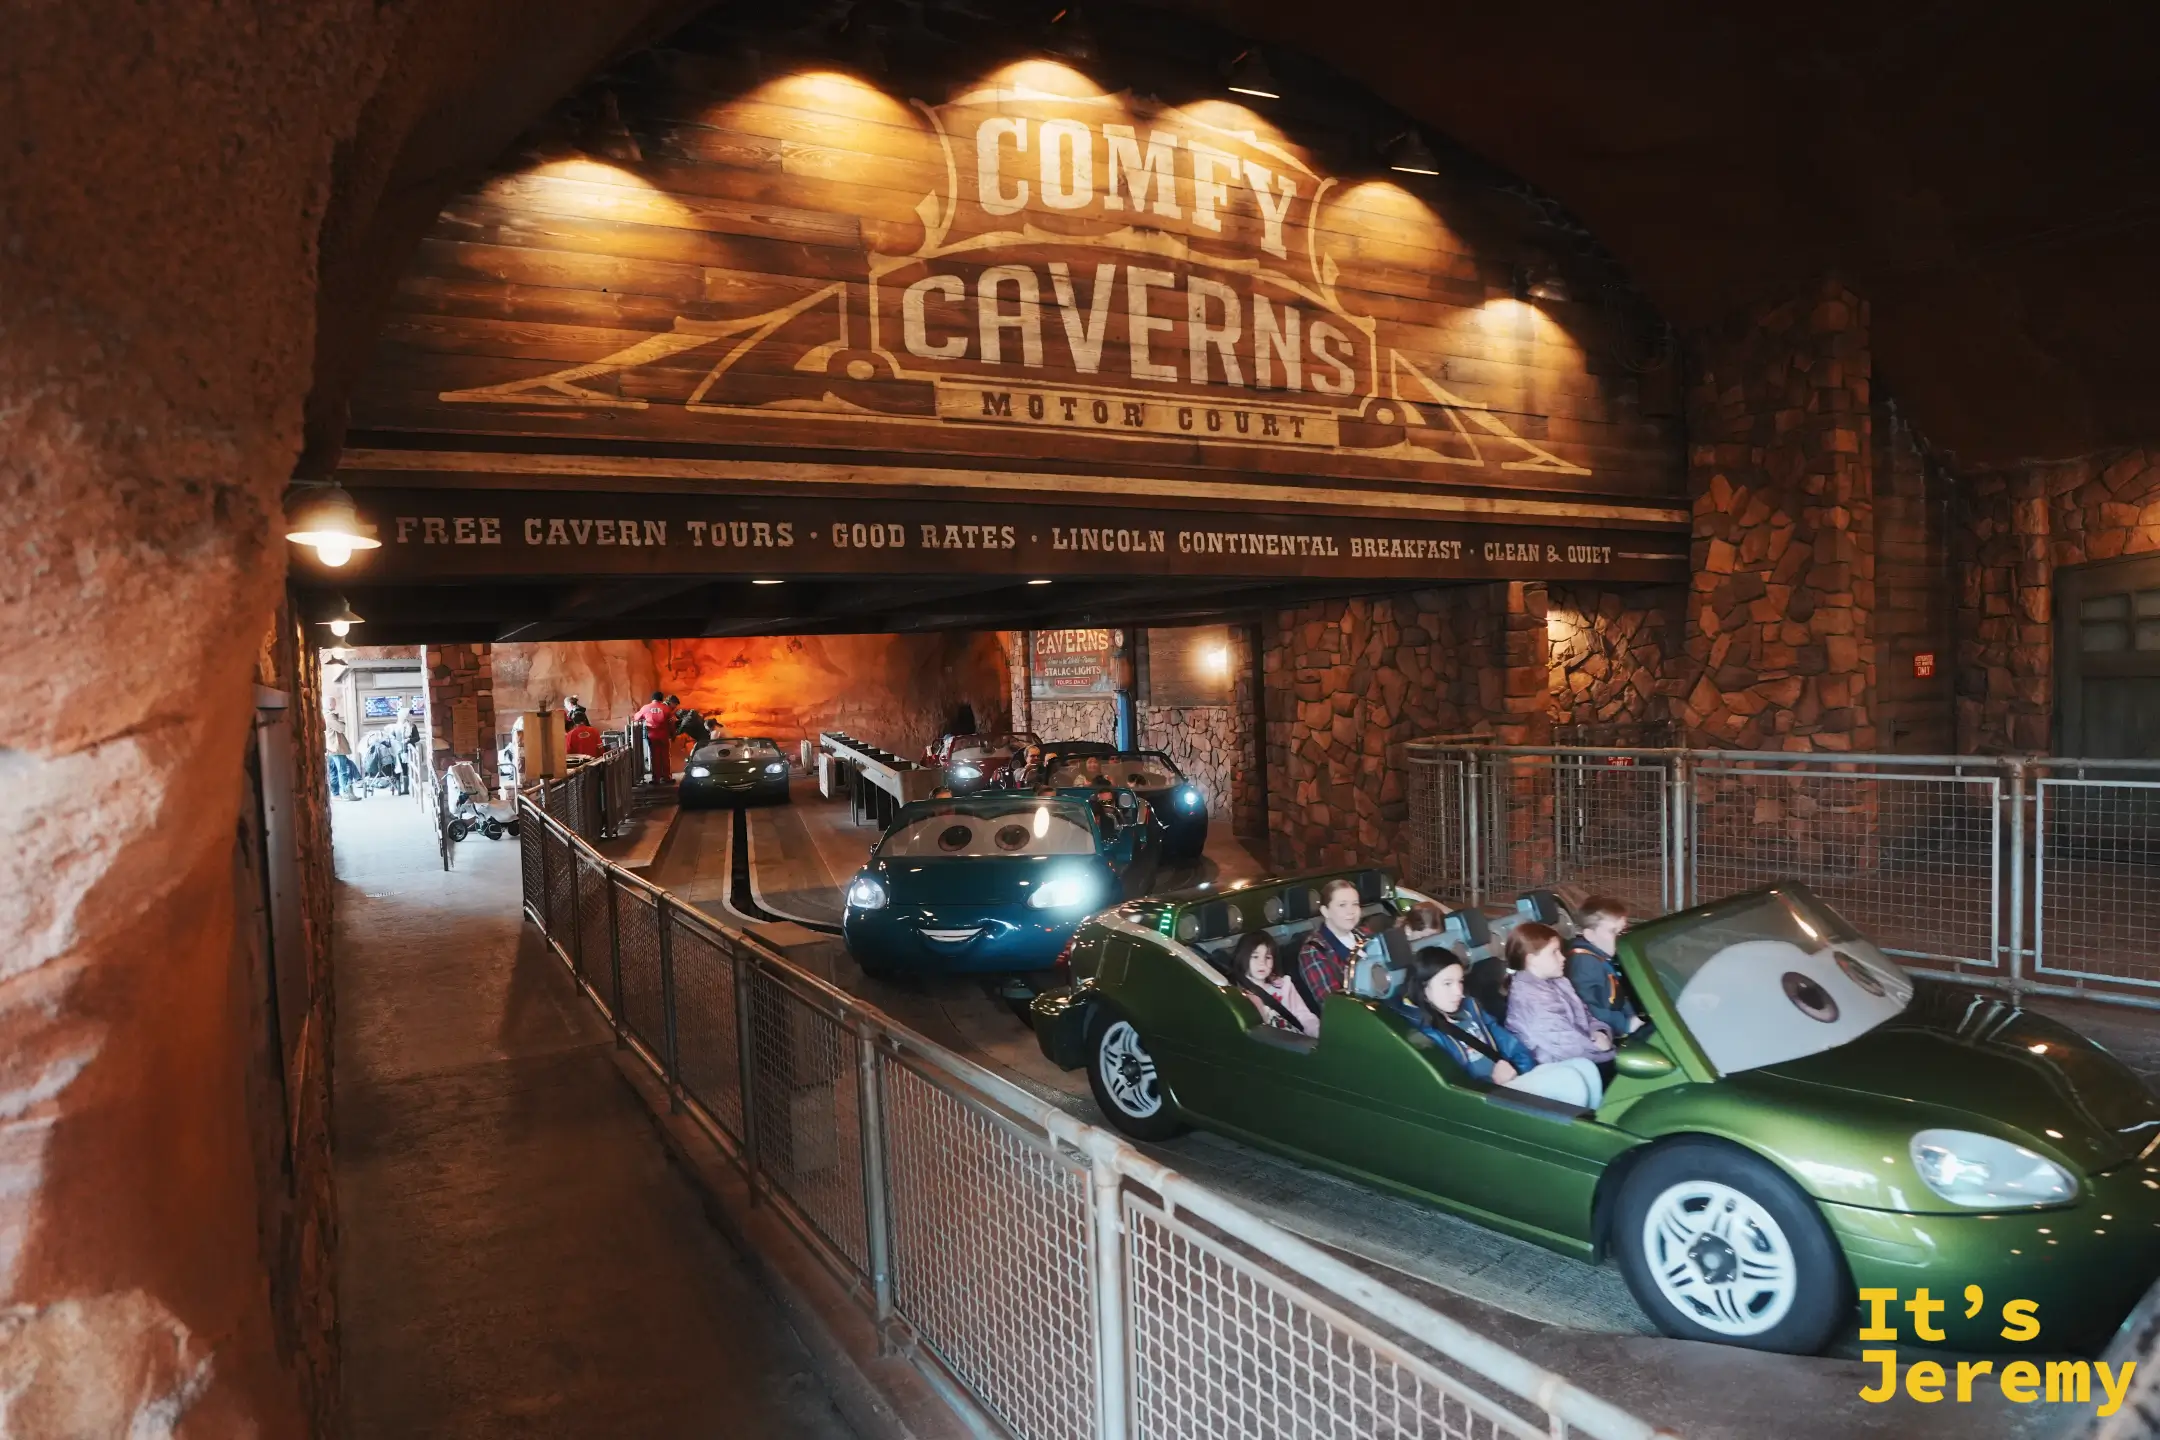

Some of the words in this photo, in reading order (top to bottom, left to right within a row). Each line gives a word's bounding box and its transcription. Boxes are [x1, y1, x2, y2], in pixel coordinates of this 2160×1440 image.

[975, 116, 1297, 260] COMFY
[902, 262, 1357, 396] CAVERNS
[982, 391, 1144, 427] MOTOR
[1177, 407, 1306, 440] COURT
[395, 516, 501, 545] FREE
[524, 518, 667, 547] CAVERN
[687, 521, 794, 548] TOURS
[832, 523, 905, 548] GOOD
[920, 524, 1015, 549] RATES
[1052, 527, 1165, 553] LINCOLN
[1178, 531, 1339, 557] CONTINENTAL
[1351, 537, 1461, 560] BREAKFAST
[1484, 541, 1540, 562] CLEAN
[1546, 545, 1563, 562] &
[1567, 545, 1611, 564] QUIET
[1036, 629, 1109, 654] CAVERNS
[1044, 666, 1101, 676] STALAC-LIGHTS
